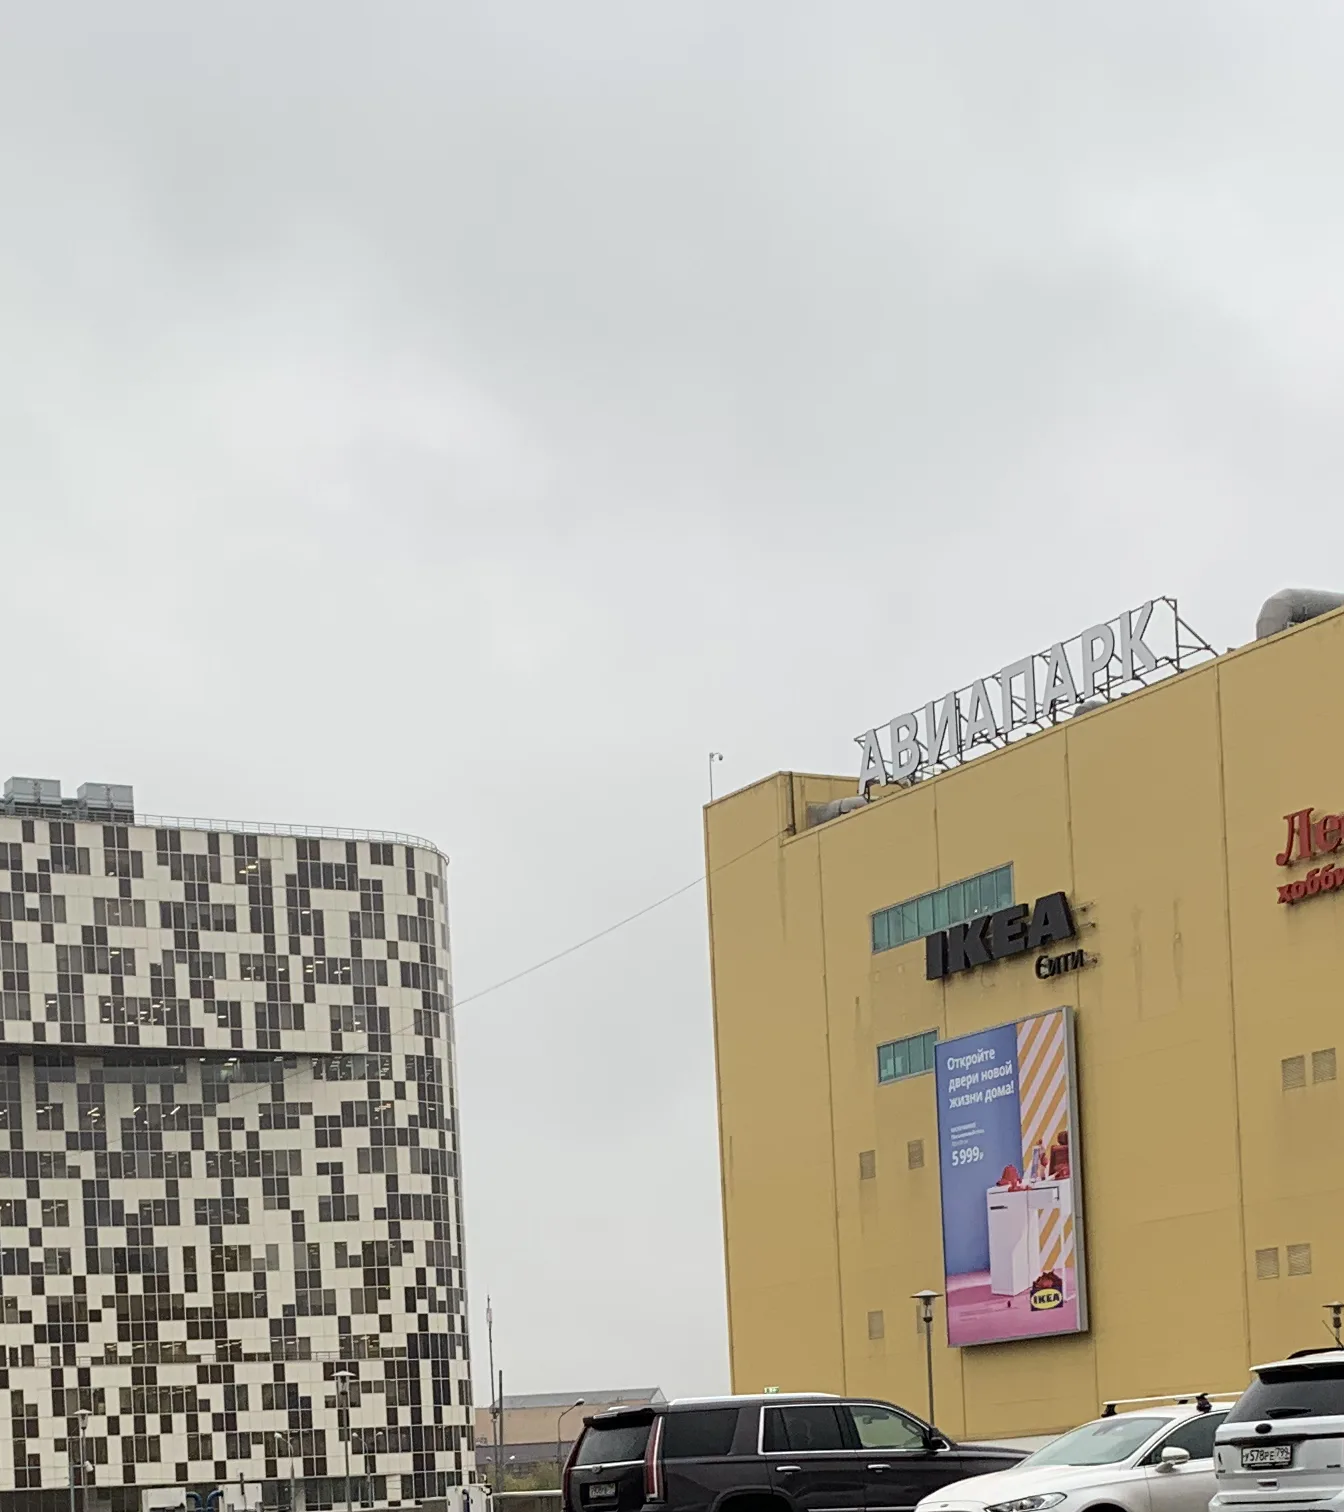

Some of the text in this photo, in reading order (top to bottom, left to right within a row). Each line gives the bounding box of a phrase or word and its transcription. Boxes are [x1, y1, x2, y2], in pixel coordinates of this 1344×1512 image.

[858, 600, 1156, 796] АВИАПАРК
[926, 891, 1076, 980] IKEA
[947, 1048, 996, 1070] Откройте
[948, 1060, 1013, 1093] двери новой
[949, 1080, 1014, 1109] жизни дома!
[1033, 1293, 1060, 1305] IKEA
